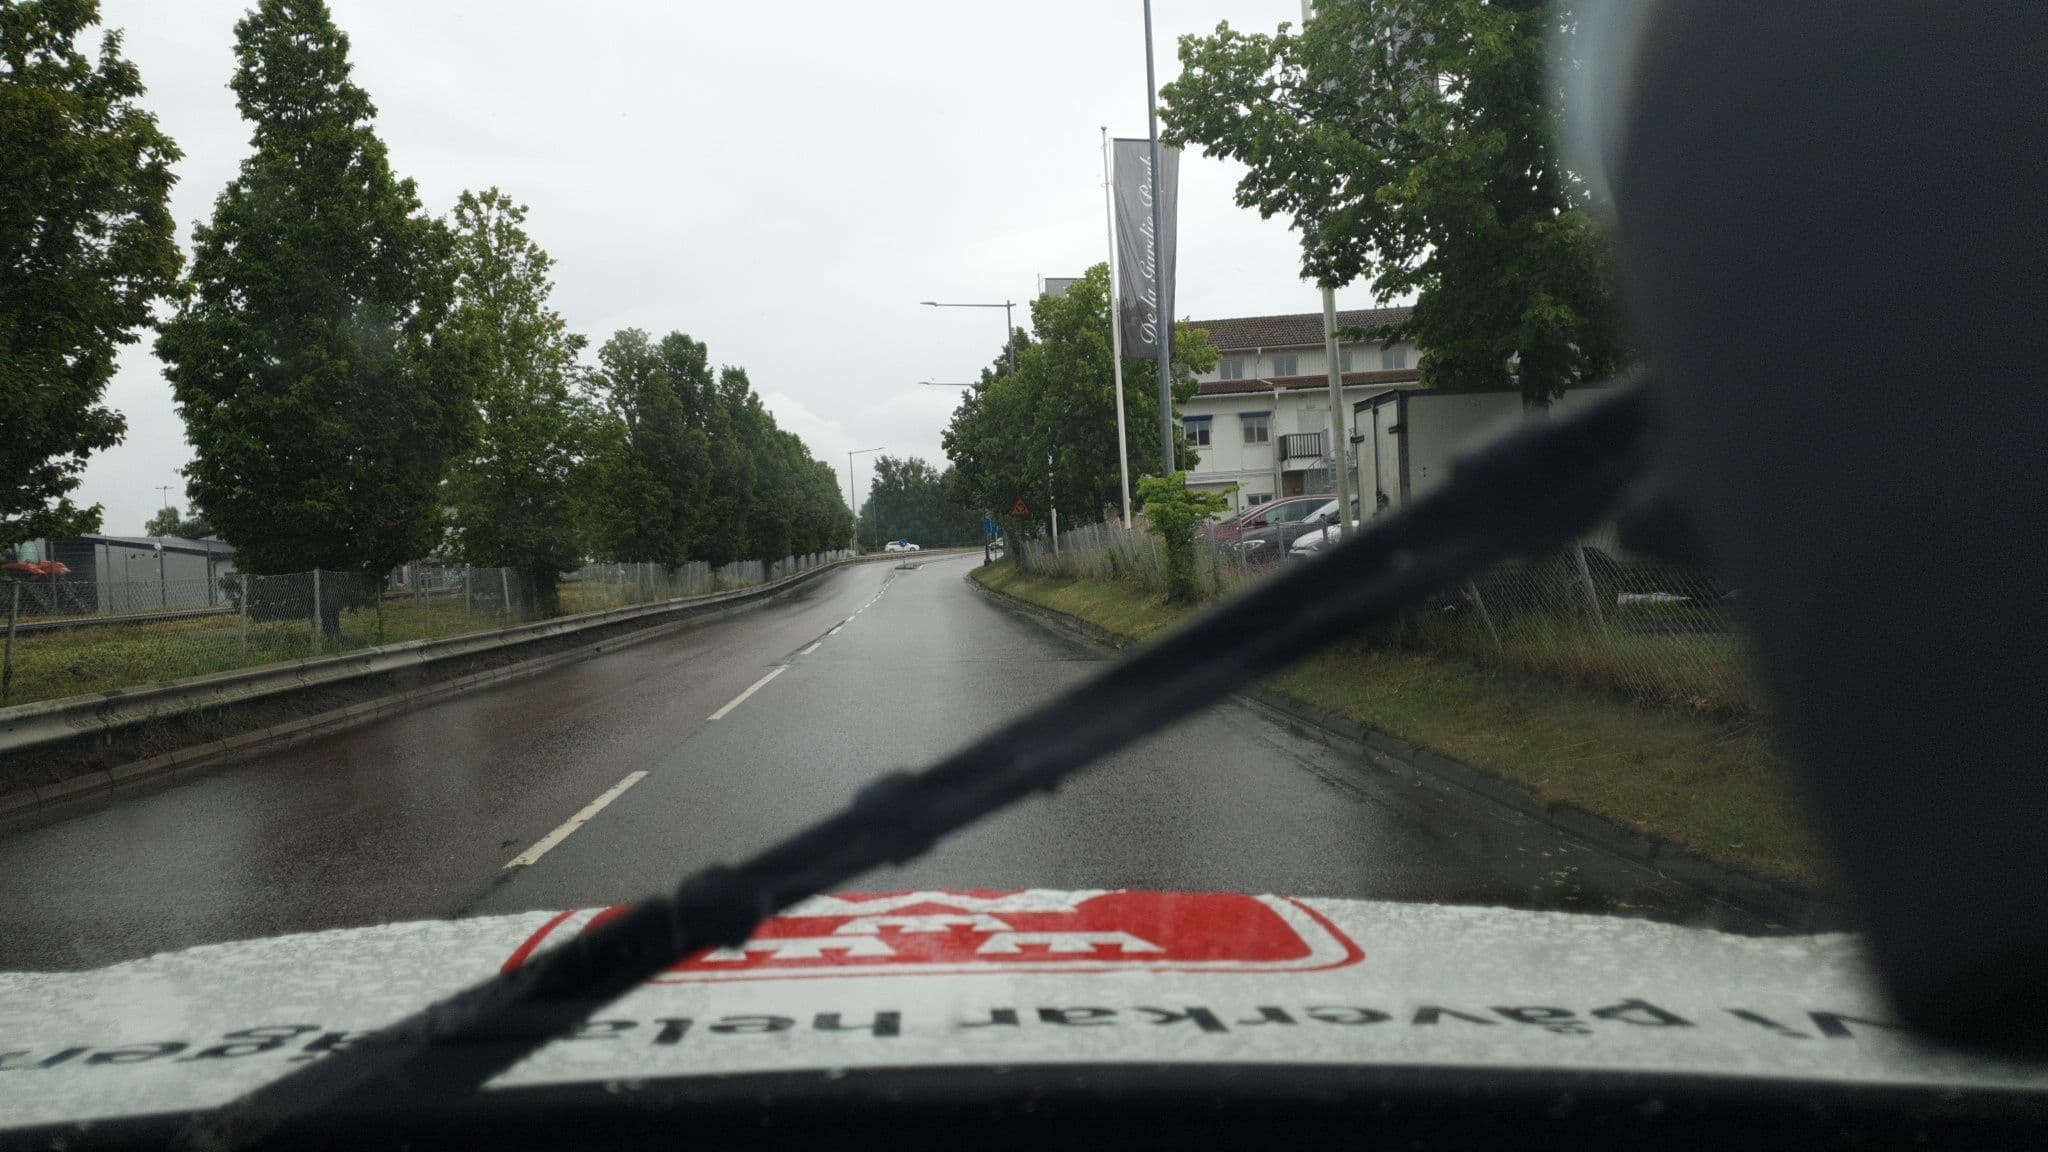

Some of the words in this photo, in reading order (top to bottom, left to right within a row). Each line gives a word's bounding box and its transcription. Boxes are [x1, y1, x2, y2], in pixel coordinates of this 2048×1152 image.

[1139, 214, 1156, 284] Gardie
[1139, 287, 1157, 309] la
[1140, 312, 1159, 345] De
[572, 1011, 902, 1045] hela
[956, 998, 1698, 1036] påverkar
